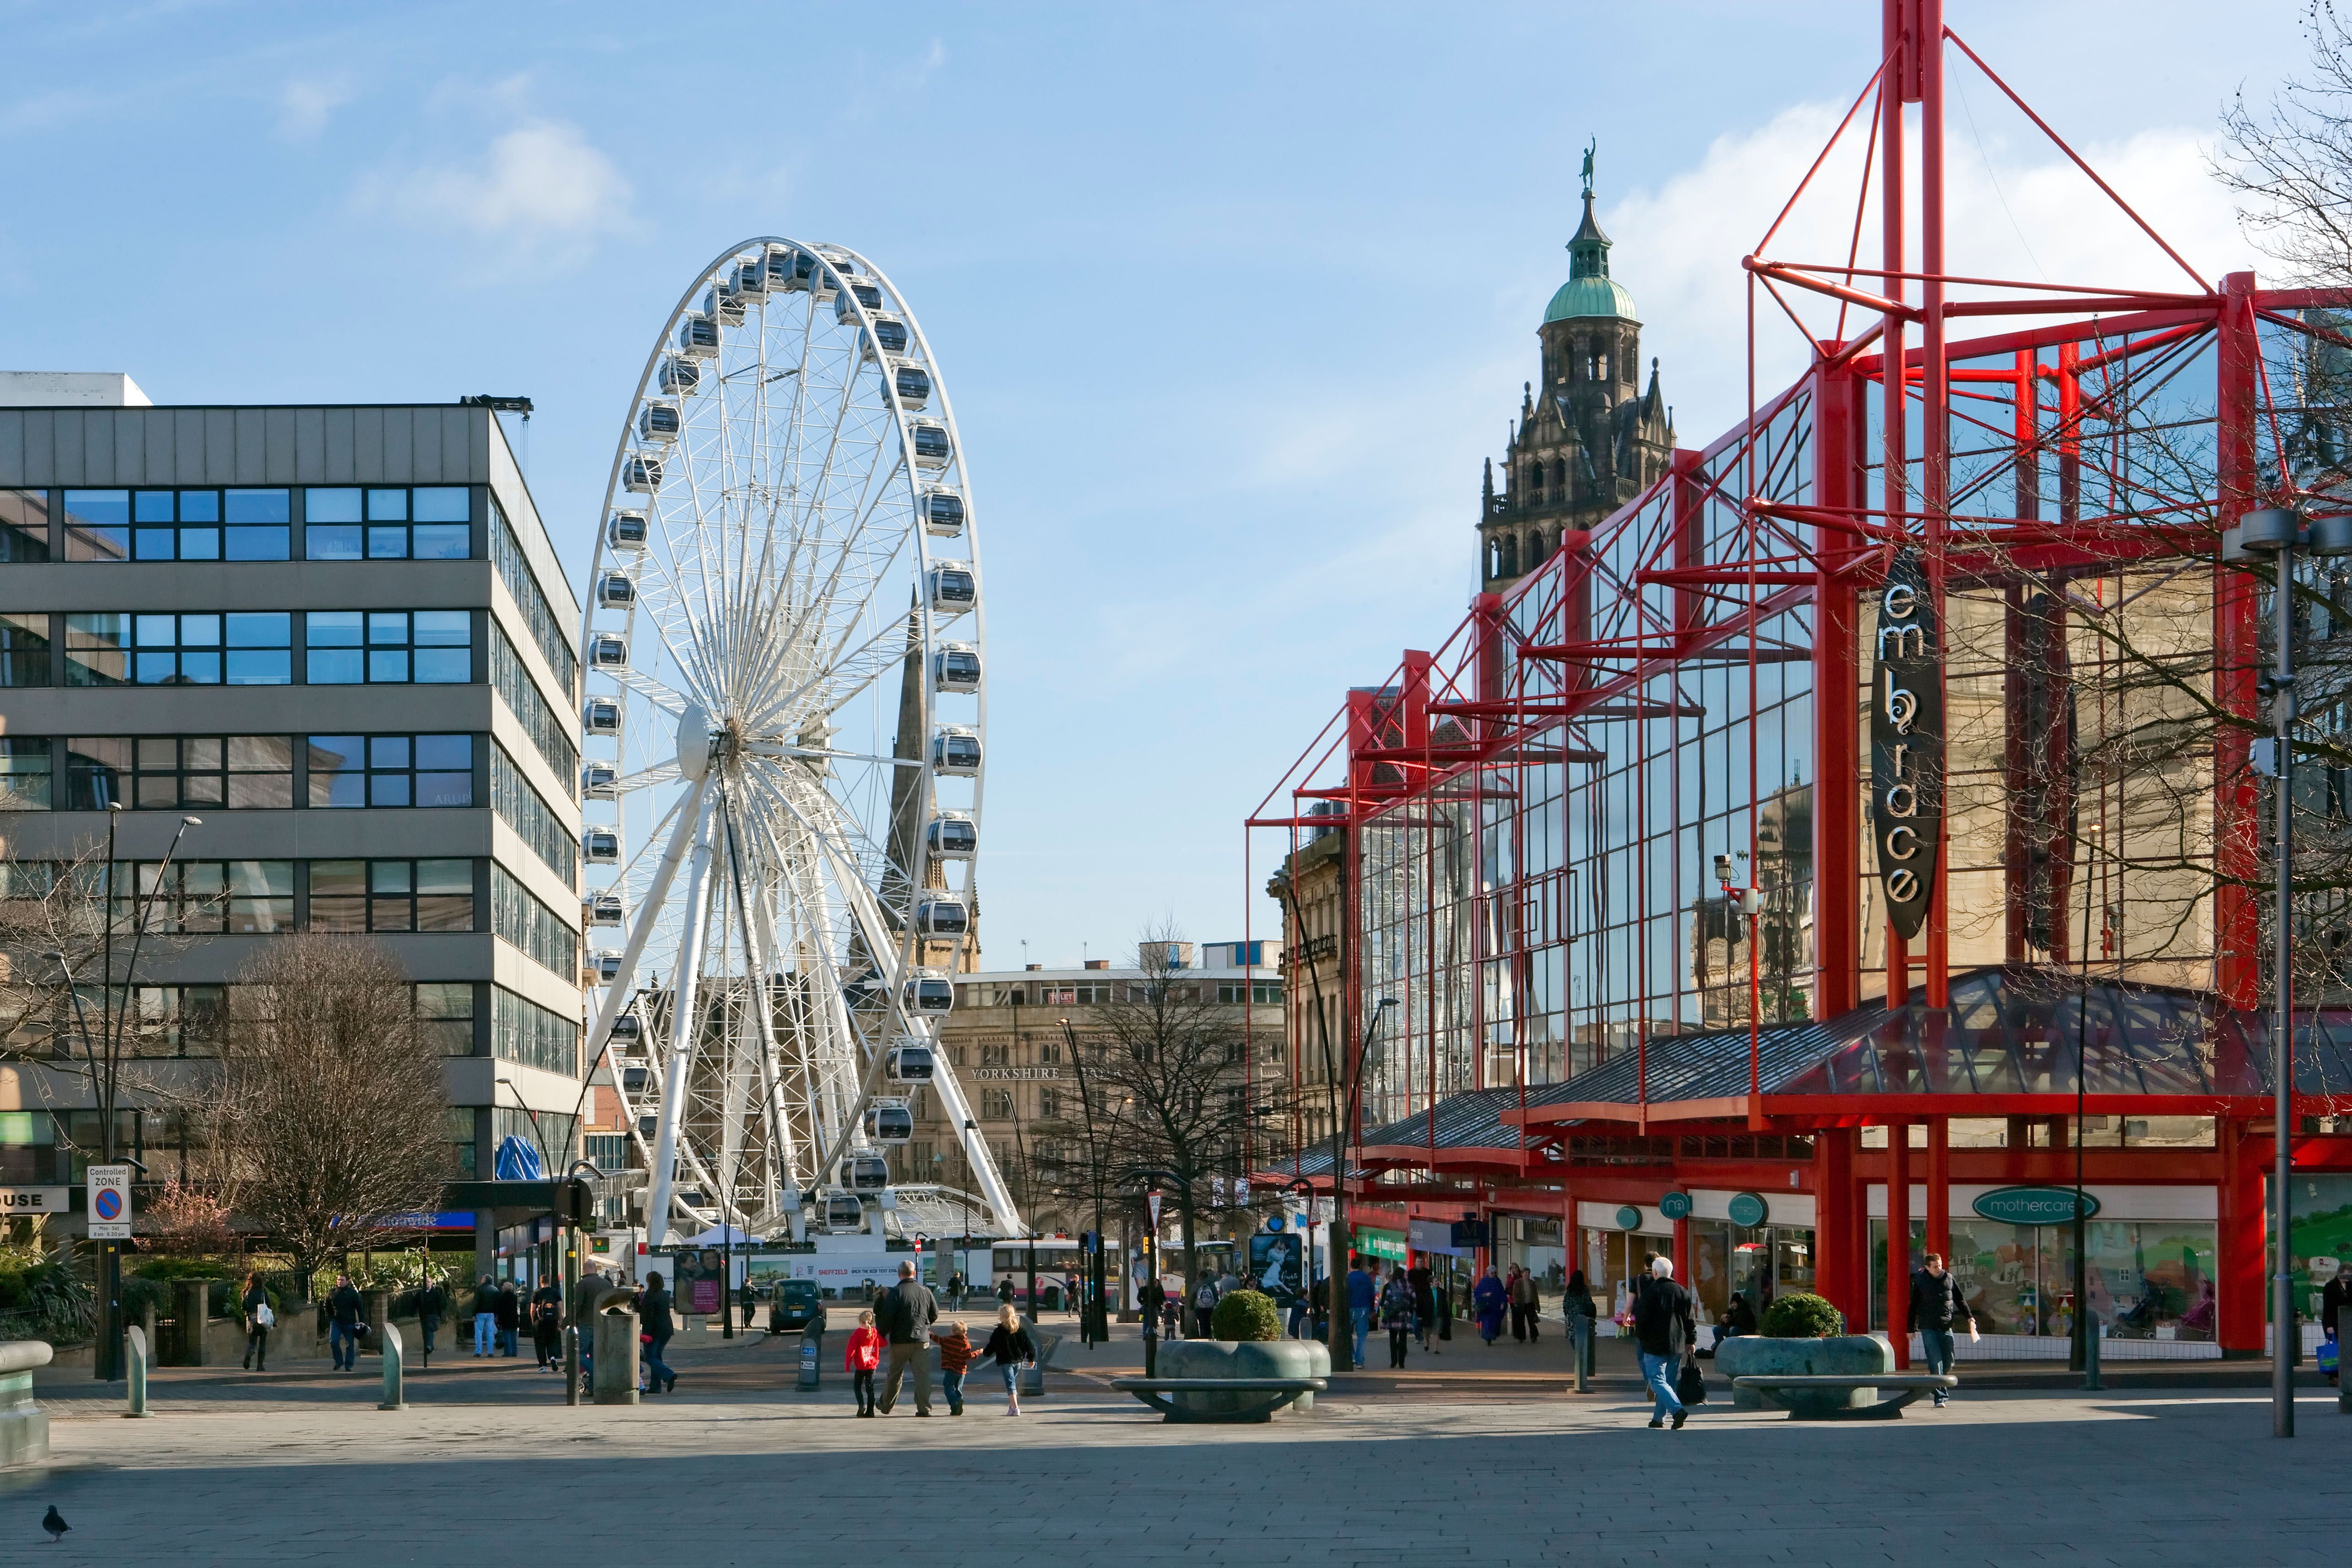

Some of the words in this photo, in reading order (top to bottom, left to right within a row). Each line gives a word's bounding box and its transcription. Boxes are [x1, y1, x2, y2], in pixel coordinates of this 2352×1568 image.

[1878, 584, 1926, 903] embrace
[435, 793, 469, 804] ARUP
[971, 1068, 1059, 1080] YORKSHIRE
[95, 1177, 121, 1186] ZONE
[0, 1194, 42, 1206] USE
[1151, 1197, 1159, 1206] GIVE
[1990, 1199, 2076, 1212] mothercare
[1373, 1236, 1381, 1252] early
[1382, 1236, 1395, 1255] learning
[1395, 1241, 1407, 1253] centre
